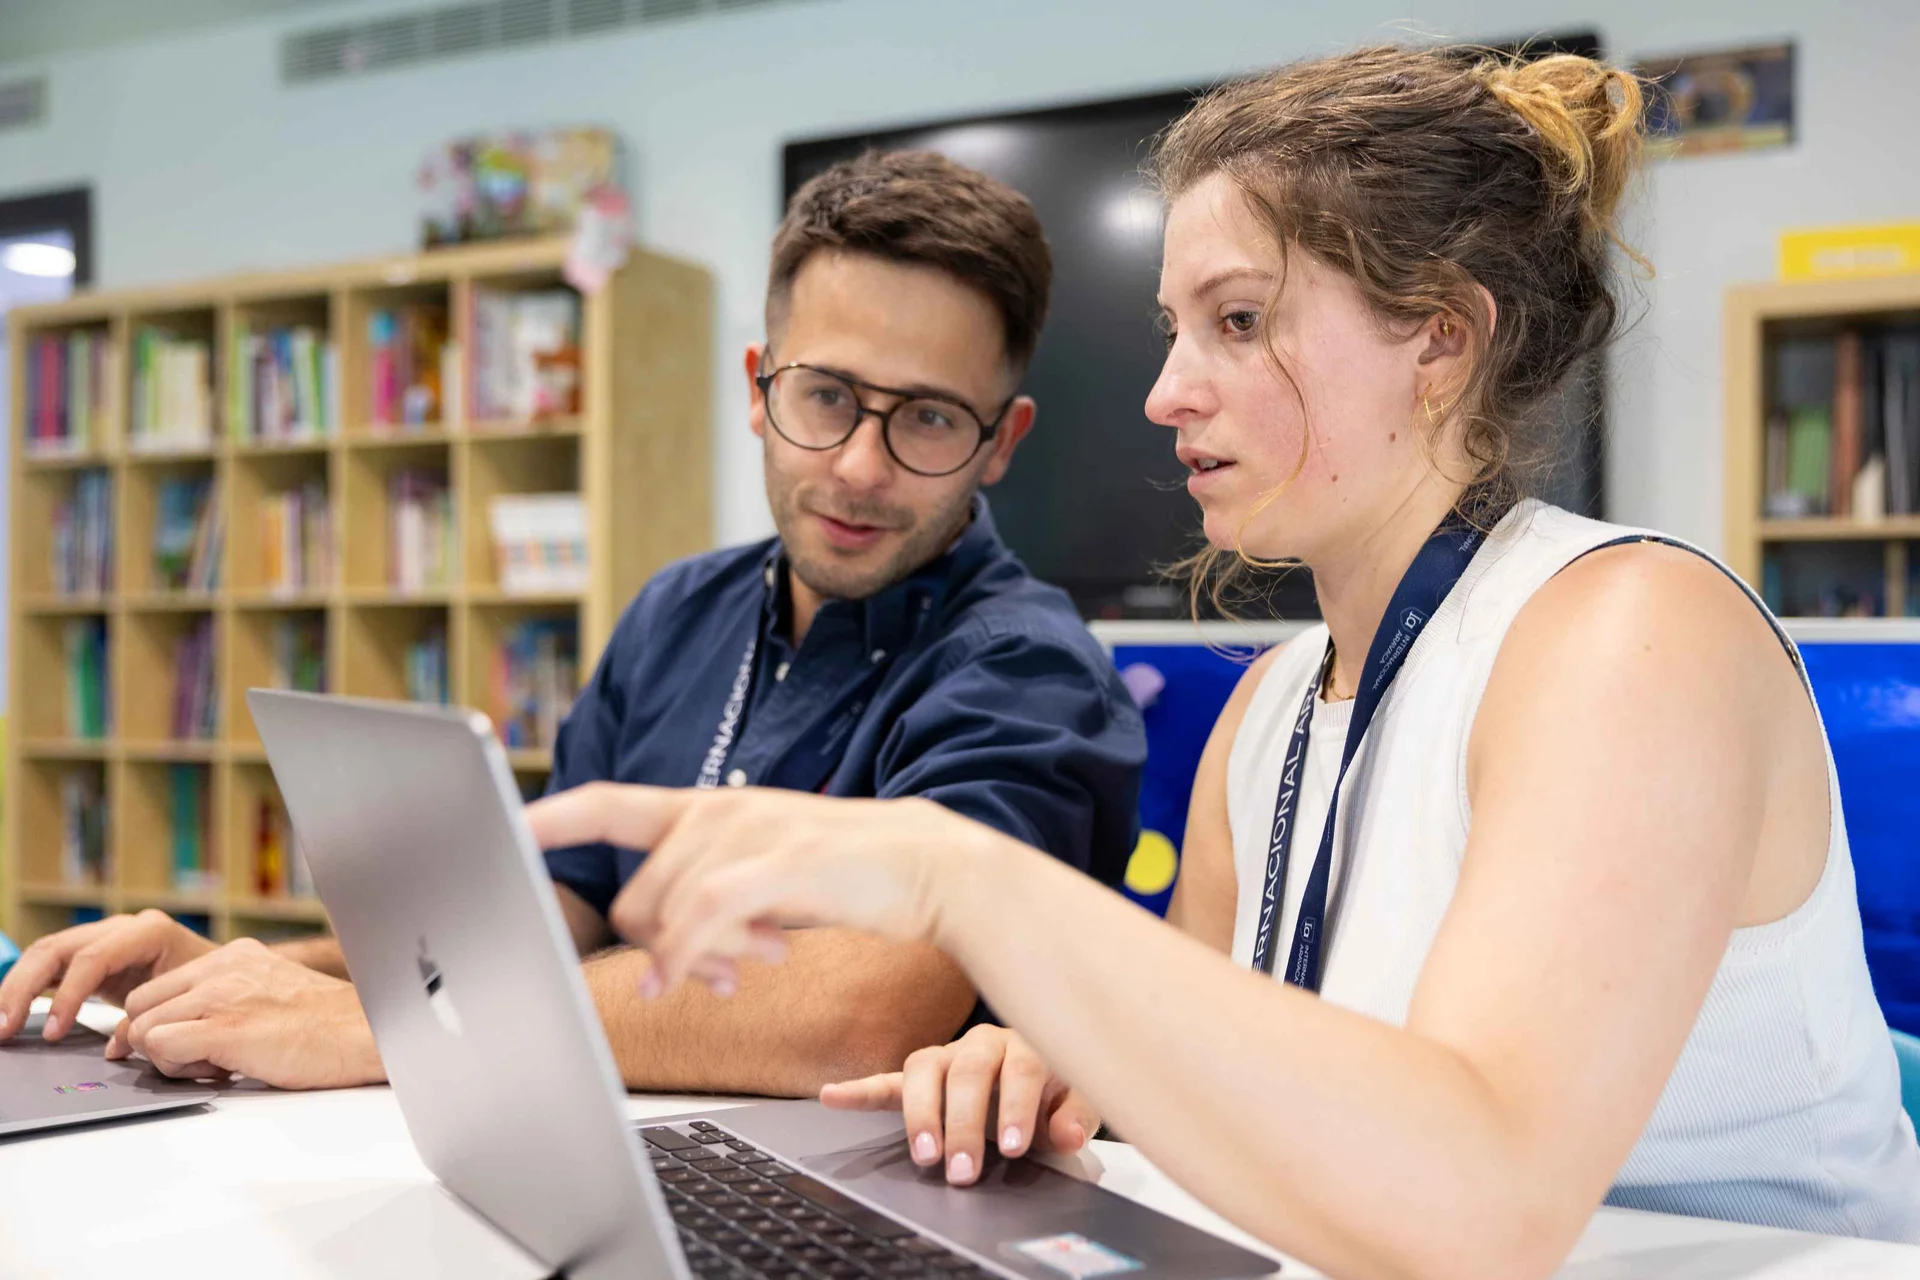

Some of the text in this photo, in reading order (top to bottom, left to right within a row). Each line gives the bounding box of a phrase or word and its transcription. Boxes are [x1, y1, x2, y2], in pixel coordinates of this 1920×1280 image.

[1372, 634, 1411, 691] INTERNACIONAL
[1379, 629, 1403, 664] ARAVACA
[696, 640, 756, 788] ERNACIO
[1252, 741, 1301, 972] ERNACIONAL
[1294, 943, 1304, 982] ARAVACA
[1299, 944, 1310, 988] INTERNAC
